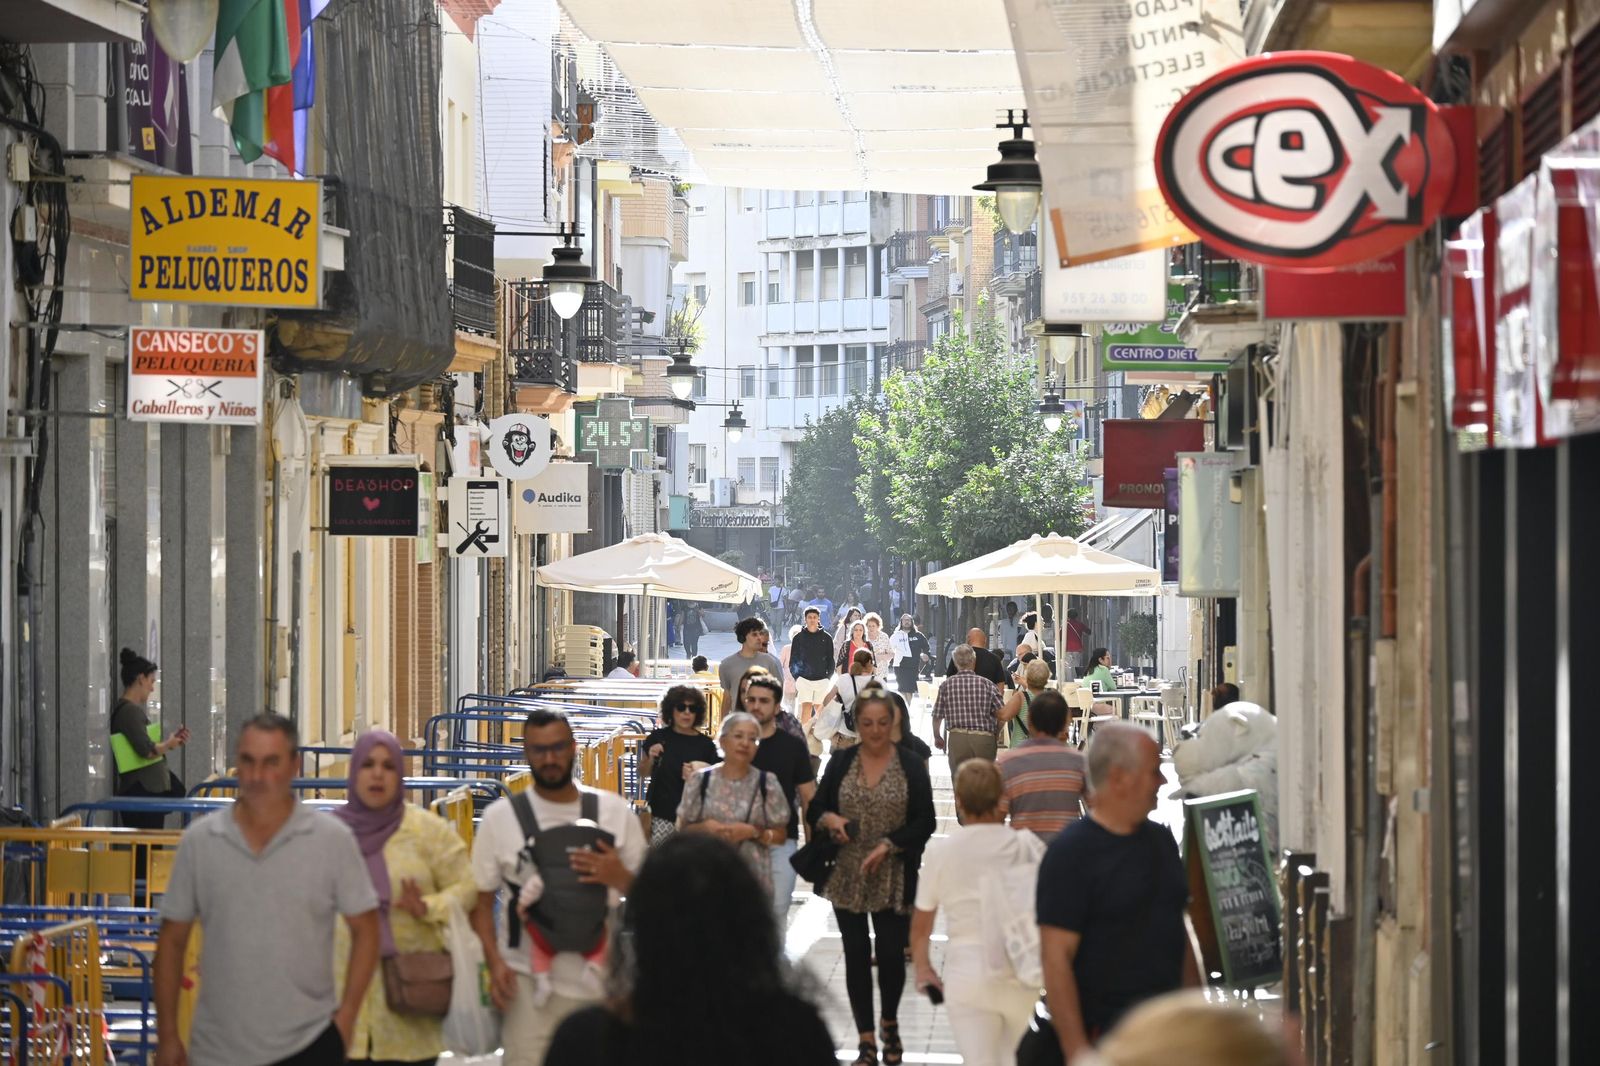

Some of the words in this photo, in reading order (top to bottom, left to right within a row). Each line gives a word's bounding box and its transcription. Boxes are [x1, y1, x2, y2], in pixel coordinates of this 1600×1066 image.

[139, 188, 311, 240] ALDEMAR
[139, 255, 309, 293] PELUQUEROS
[1114, 347, 1165, 359] CENTRO
[131, 399, 204, 417] Caballeros
[206, 404, 216, 419] y
[219, 400, 257, 418] Niños
[538, 492, 582, 503] Audika
